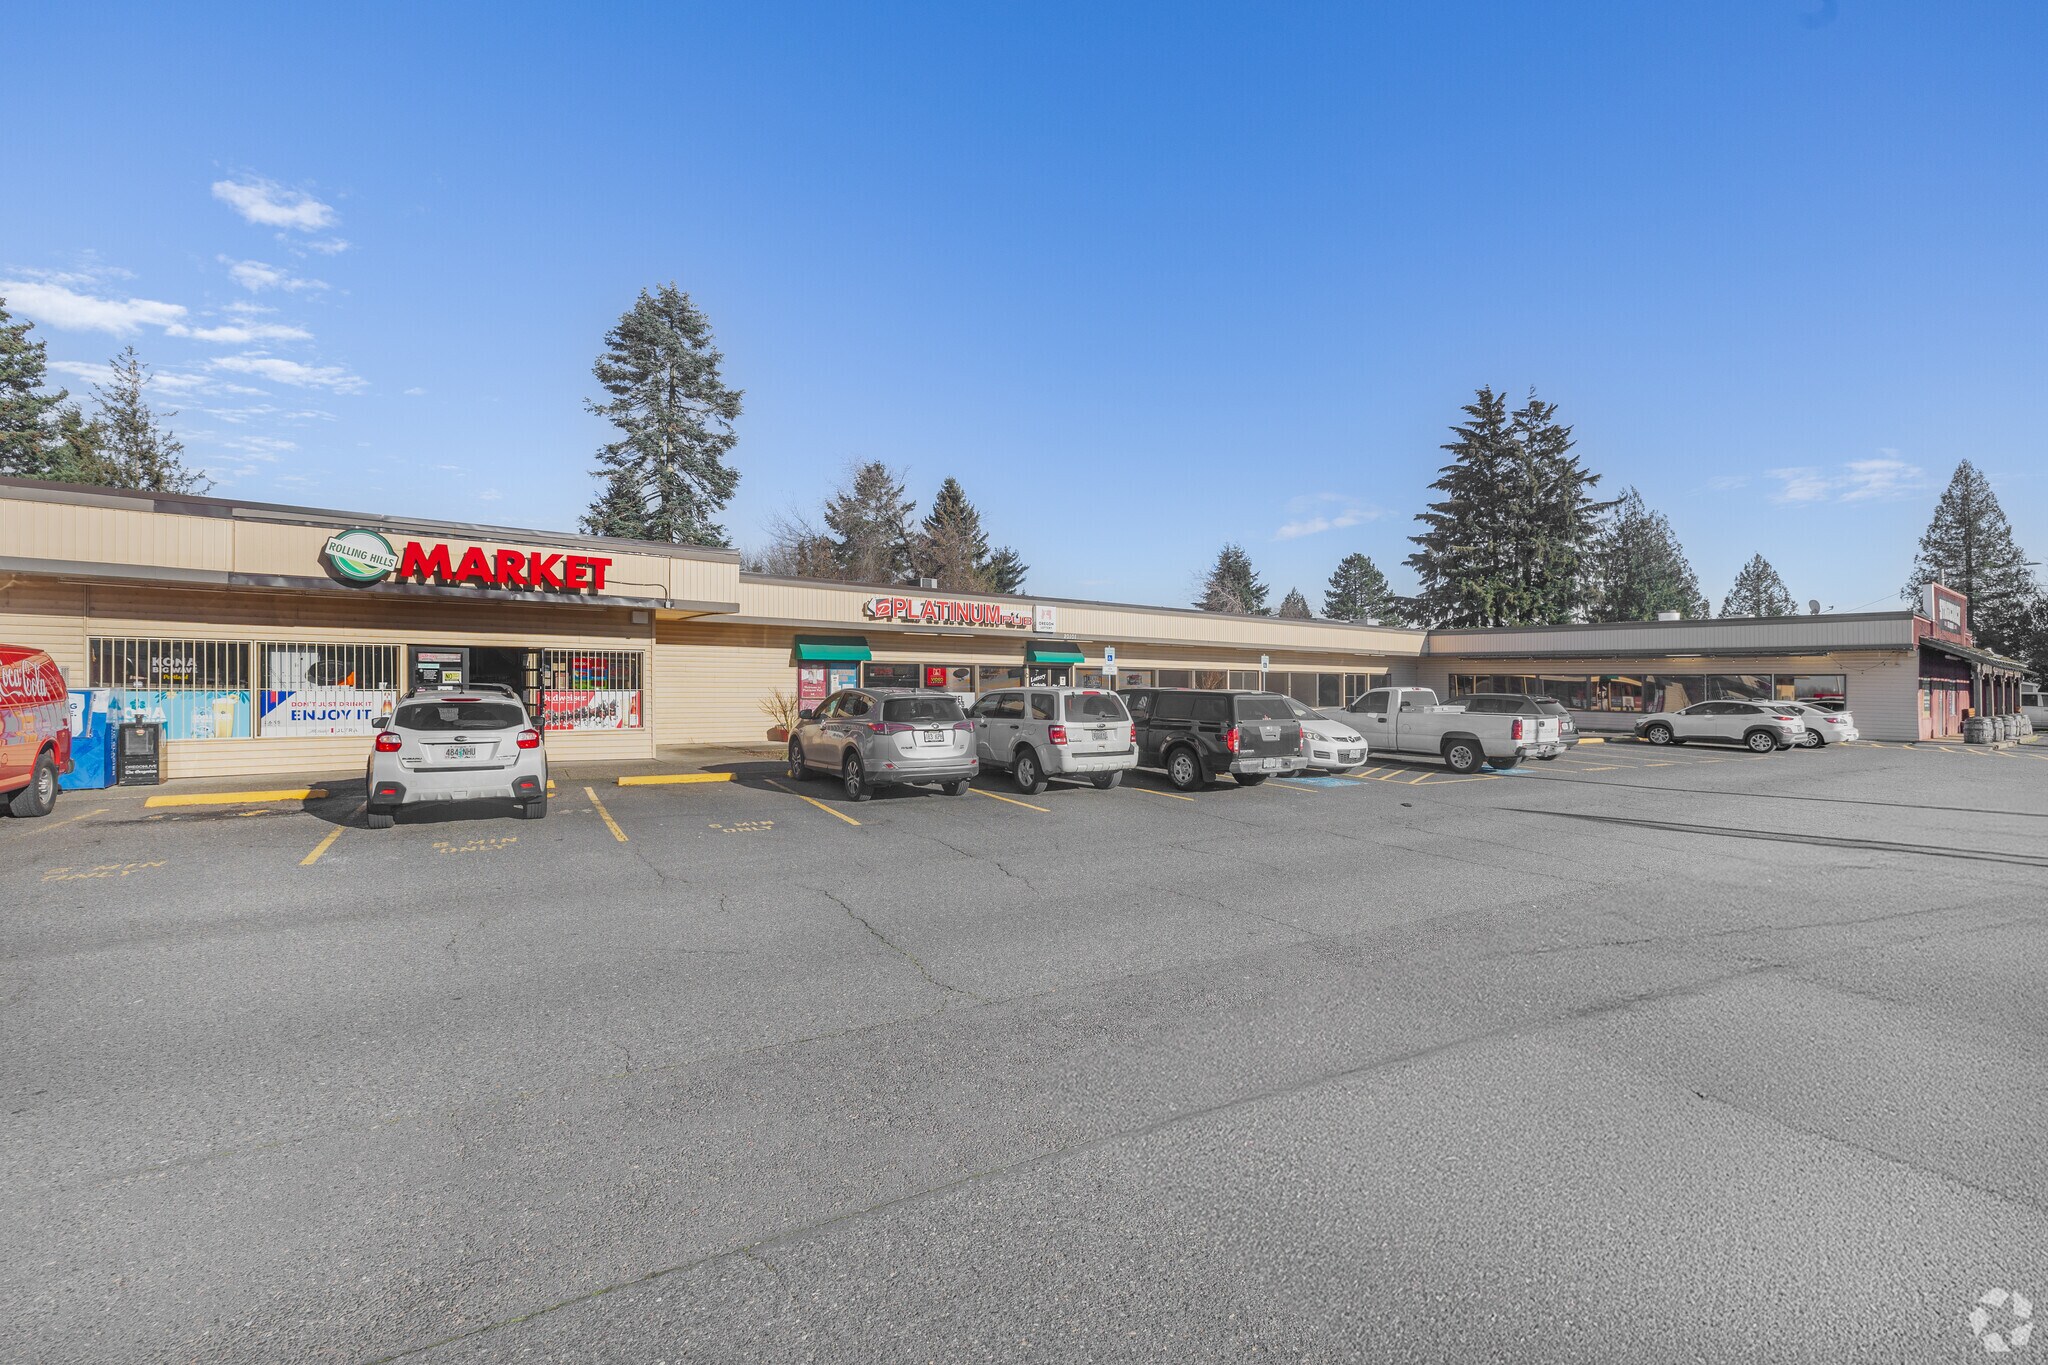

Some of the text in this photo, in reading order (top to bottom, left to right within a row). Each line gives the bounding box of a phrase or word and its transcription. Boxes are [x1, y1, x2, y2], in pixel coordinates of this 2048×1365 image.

[328, 541, 395, 568] ROLLING HILLS
[400, 541, 612, 590] MARKET
[892, 598, 1033, 626] PLATINUM PUB
[152, 656, 198, 667] KONA
[0, 660, 48, 697] oca-Cola
[1030, 674, 1047, 683] Lottery
[291, 709, 373, 721] ENJOY IT
[445, 747, 476, 757] 484 NHU
